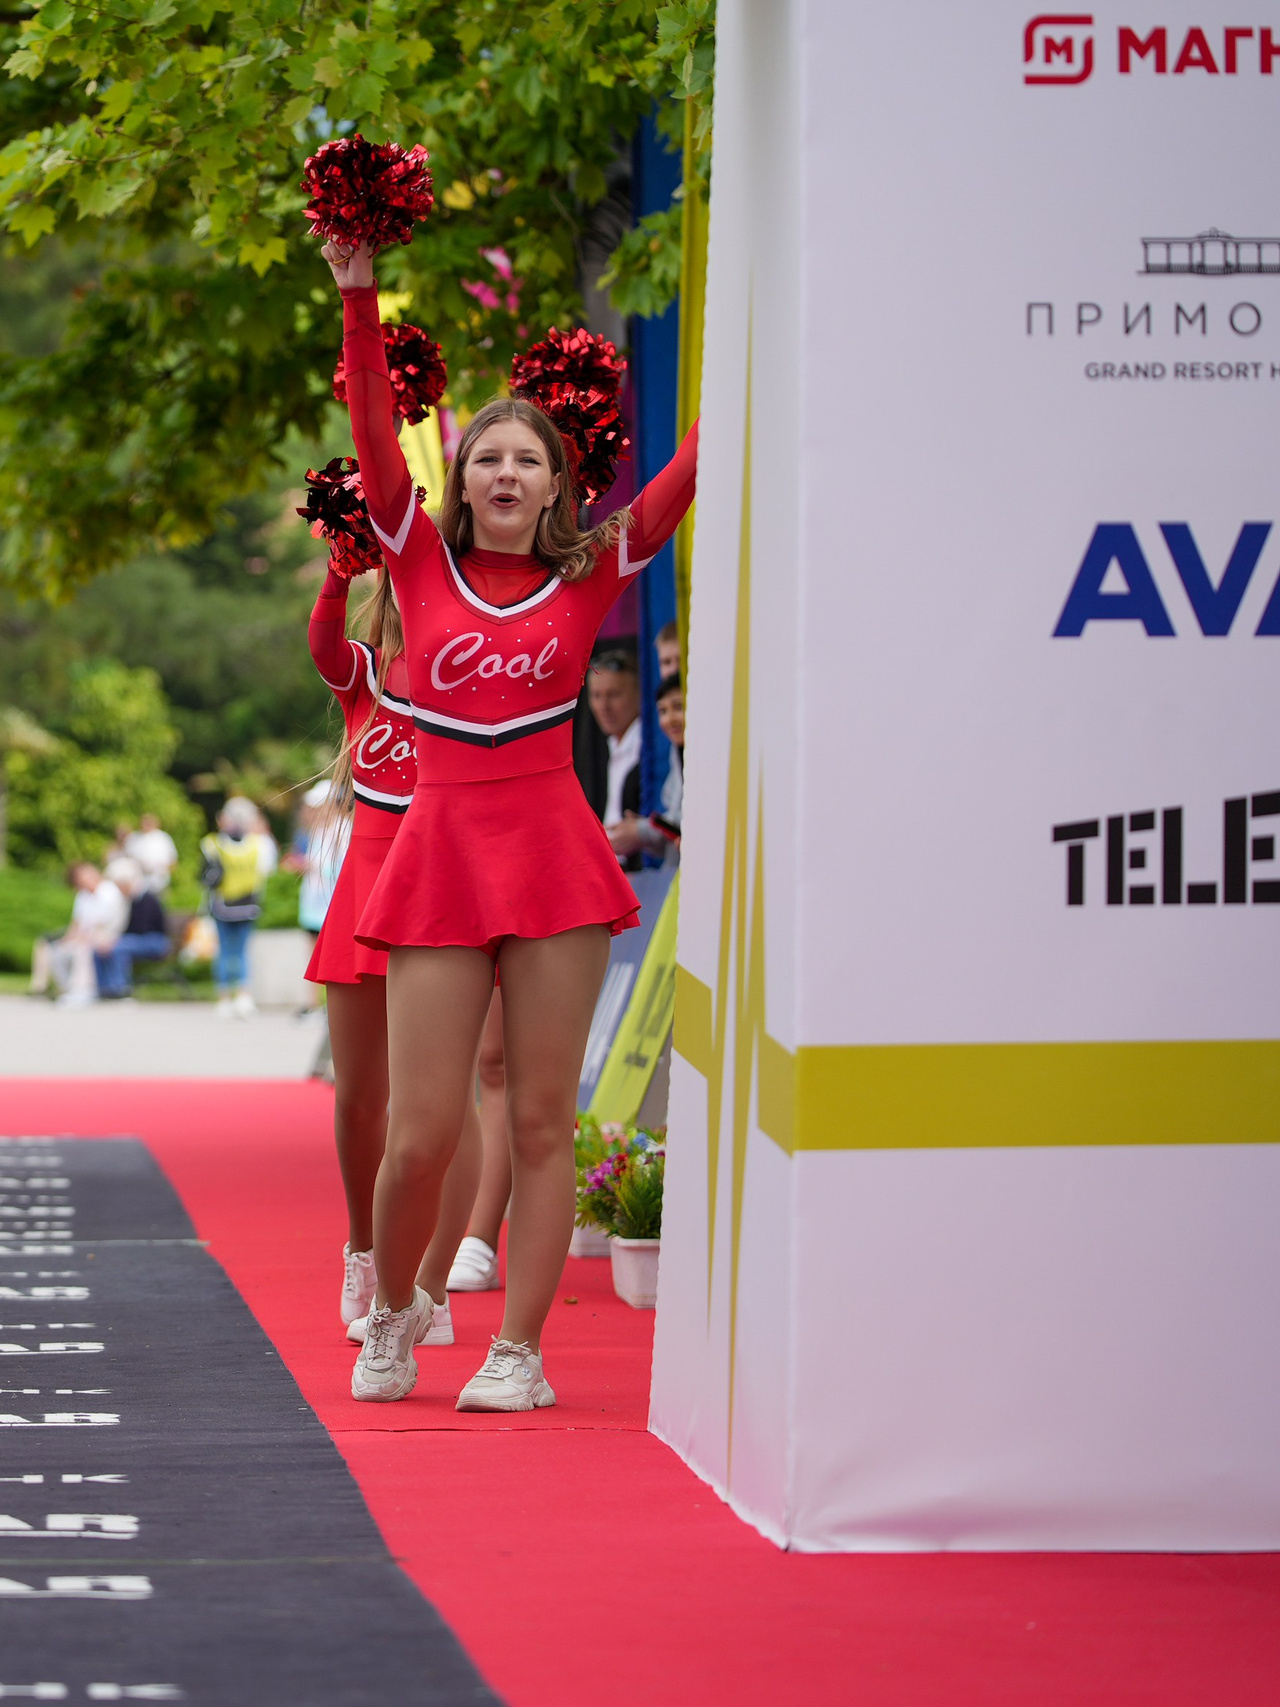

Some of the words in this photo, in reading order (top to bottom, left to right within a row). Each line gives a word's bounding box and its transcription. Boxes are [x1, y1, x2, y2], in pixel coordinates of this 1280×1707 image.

[1026, 302, 1262, 336] ПРИМО
[1085, 362, 1166, 380] GRAND
[1174, 362, 1263, 380] RESORT
[1051, 521, 1280, 637] AV
[431, 632, 558, 691] Cool
